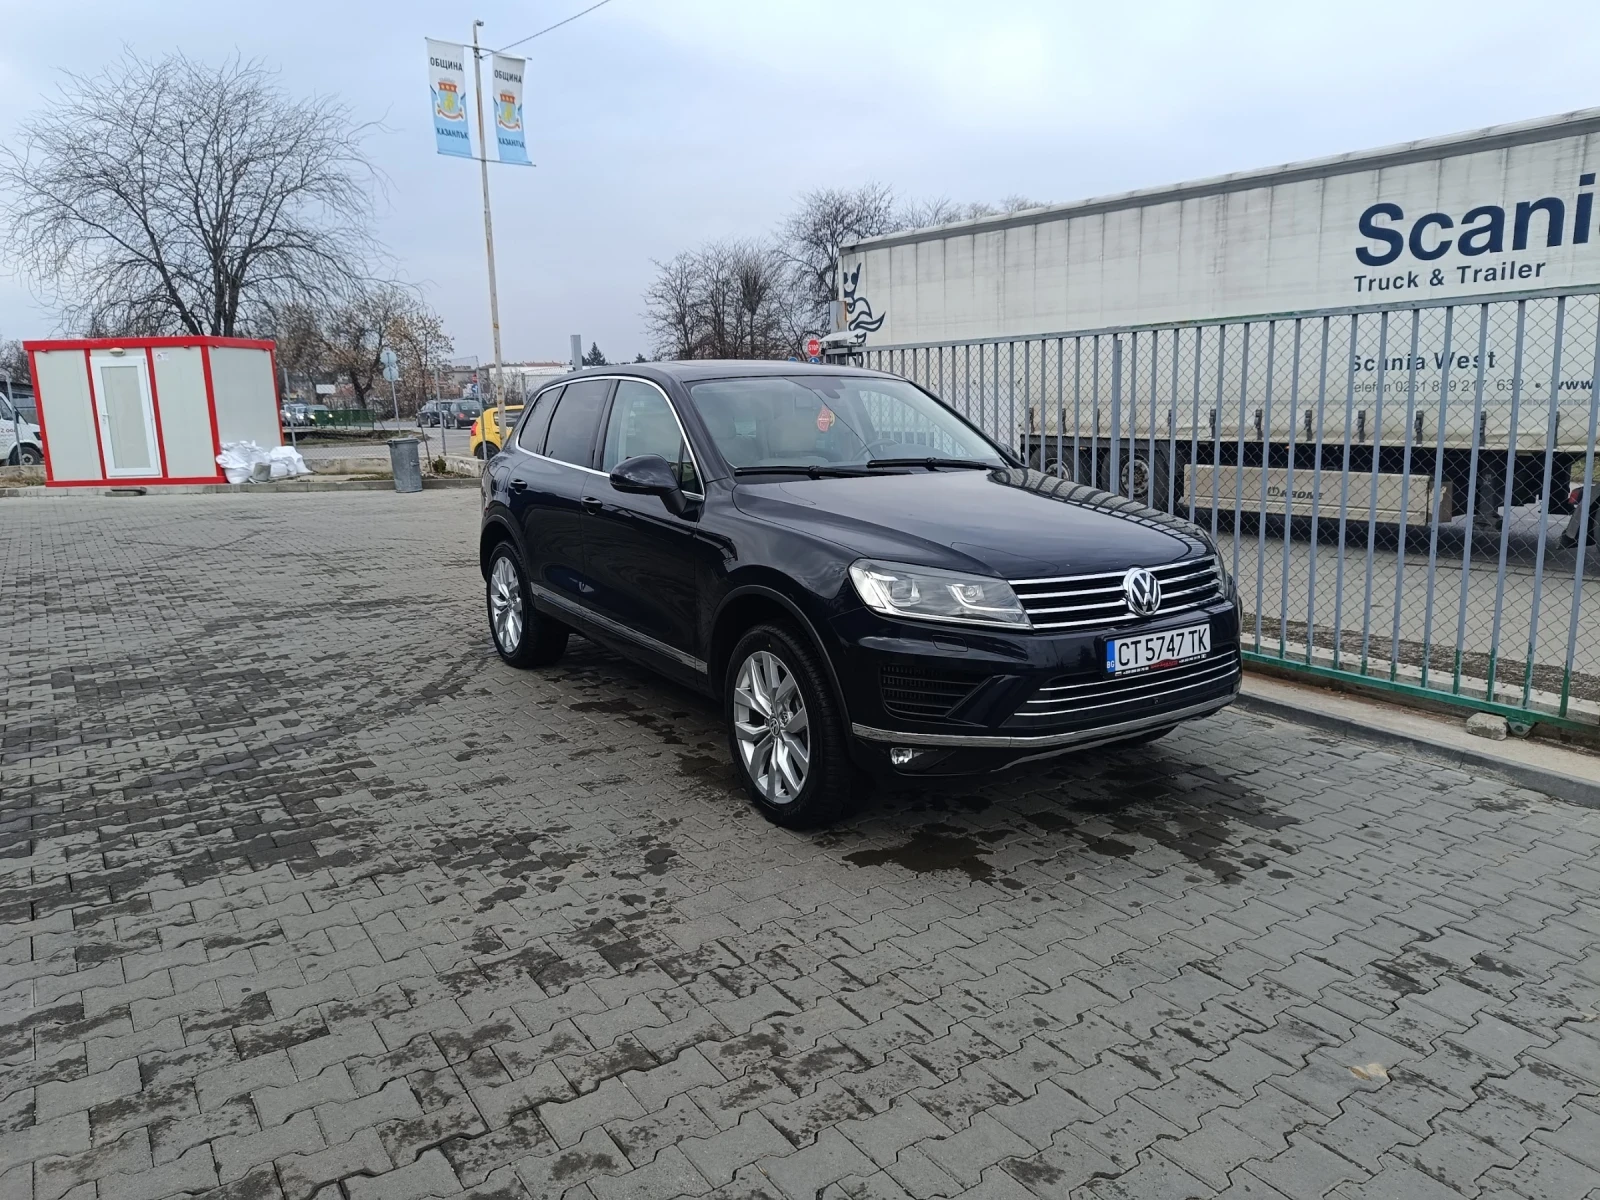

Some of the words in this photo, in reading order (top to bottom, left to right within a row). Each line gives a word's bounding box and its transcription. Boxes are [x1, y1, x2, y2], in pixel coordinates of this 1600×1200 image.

[430, 57, 463, 72] ОБЩИНА
[494, 69, 522, 84] ОБЩИНА
[436, 126, 469, 140] КАЗАНЛЪК
[1355, 172, 1600, 267] Scani
[1353, 271, 1419, 292] Truck
[1429, 268, 1445, 287] &
[1456, 260, 1546, 284] Trailer
[1352, 381, 1391, 393] elefn
[1431, 380, 1457, 392] 89
[1118, 640, 1141, 666] CT
[1146, 632, 1184, 662] 5747
[1188, 628, 1207, 653] TK
